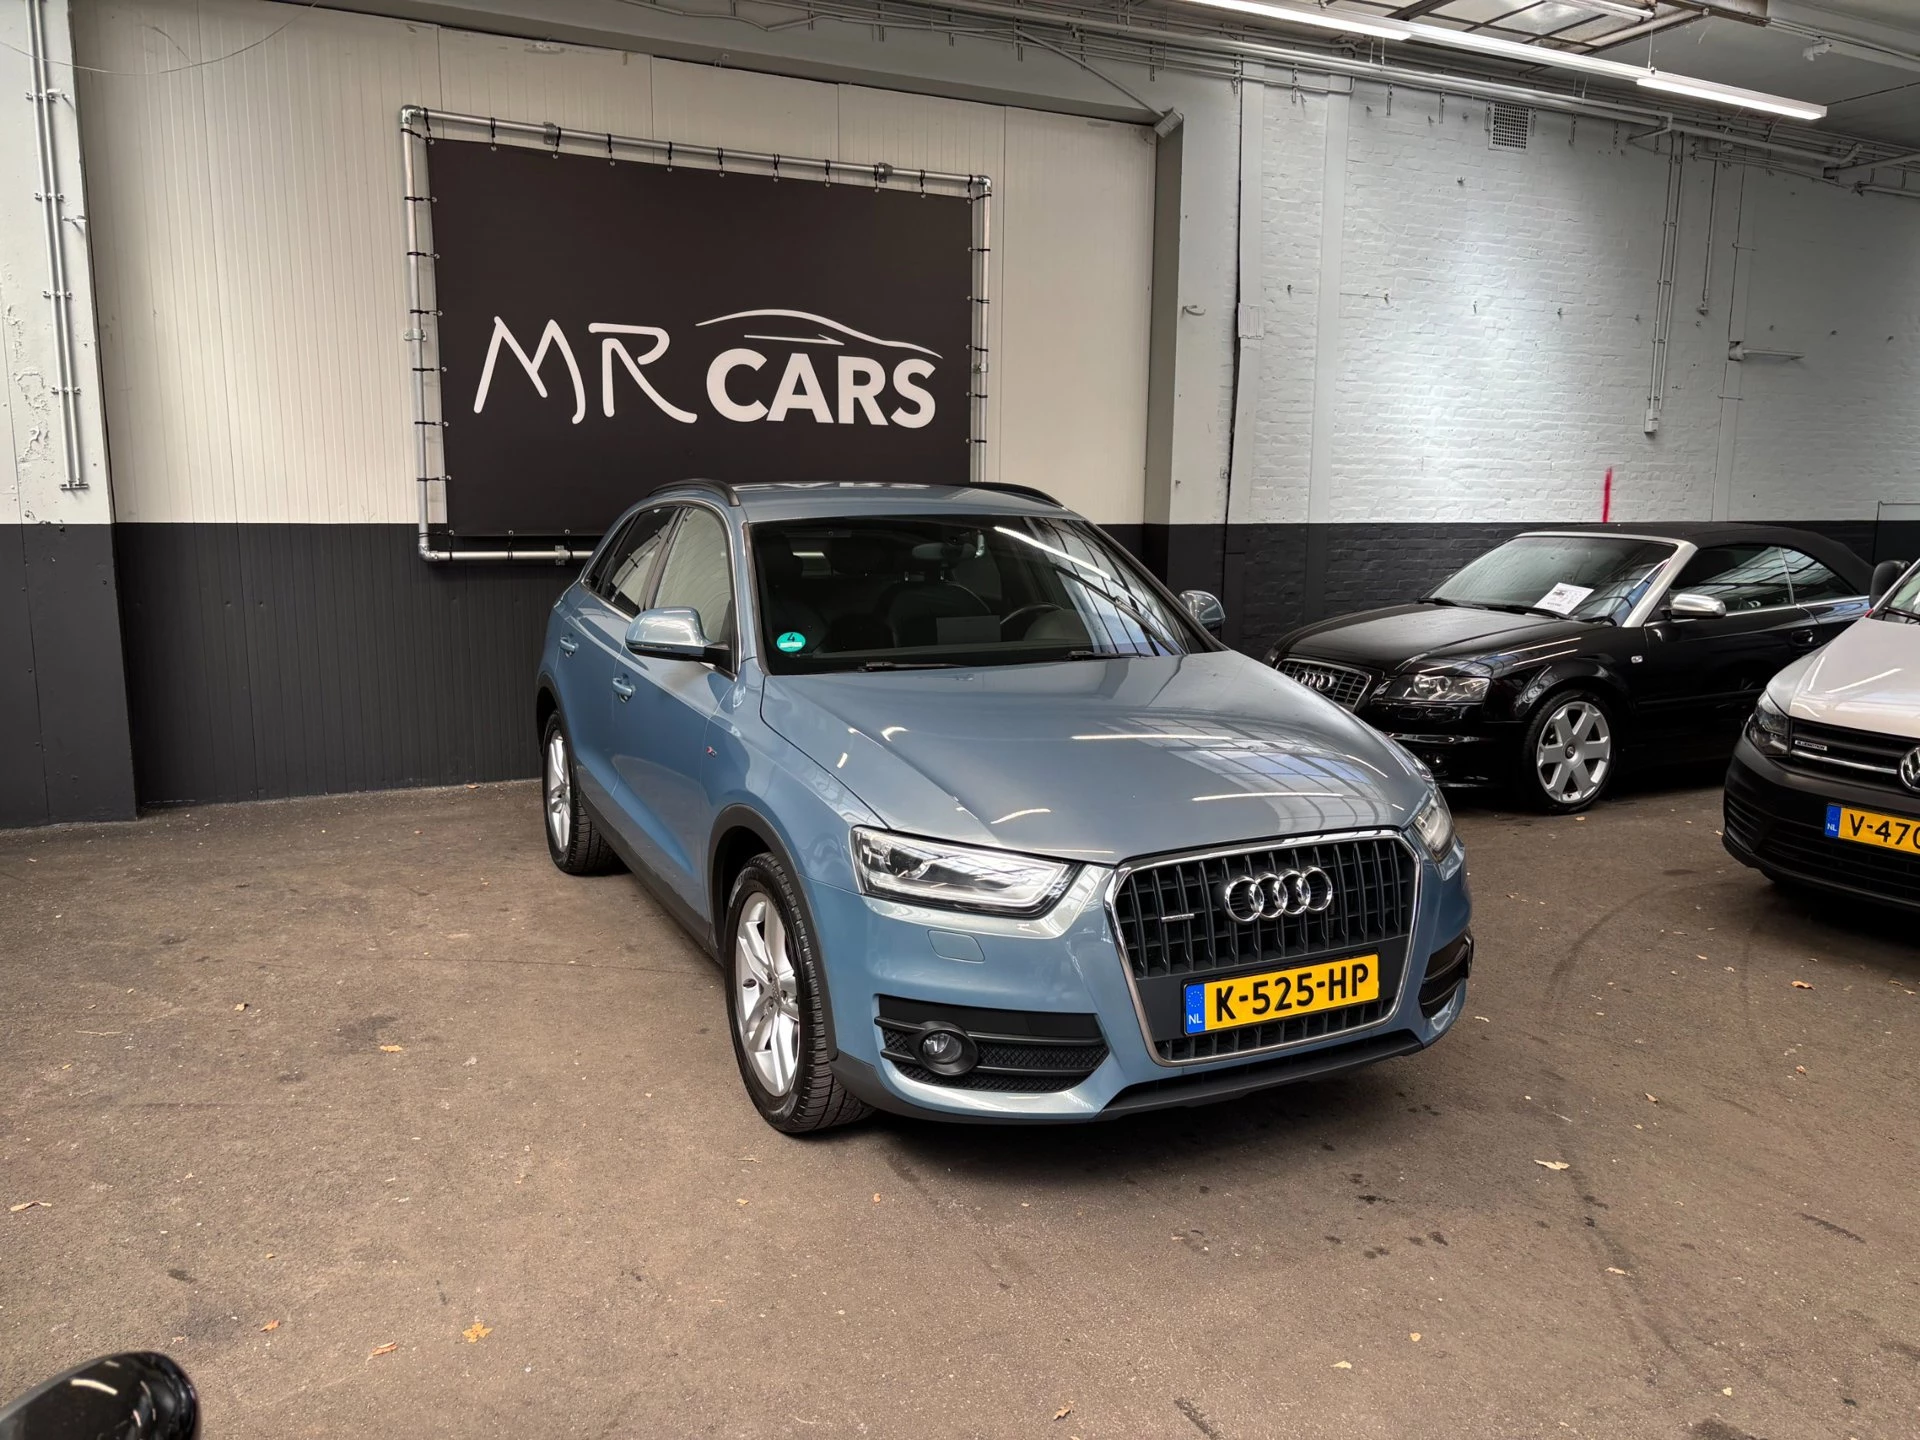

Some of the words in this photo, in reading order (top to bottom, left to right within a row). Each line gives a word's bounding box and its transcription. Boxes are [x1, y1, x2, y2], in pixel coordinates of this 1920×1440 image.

[473, 315, 698, 425] MR
[705, 347, 937, 429] CARS
[787, 632, 796, 642] 4
[1827, 823, 1838, 832] NL
[1215, 963, 1369, 1023] K-525-HP
[1188, 1013, 1202, 1025] NL
